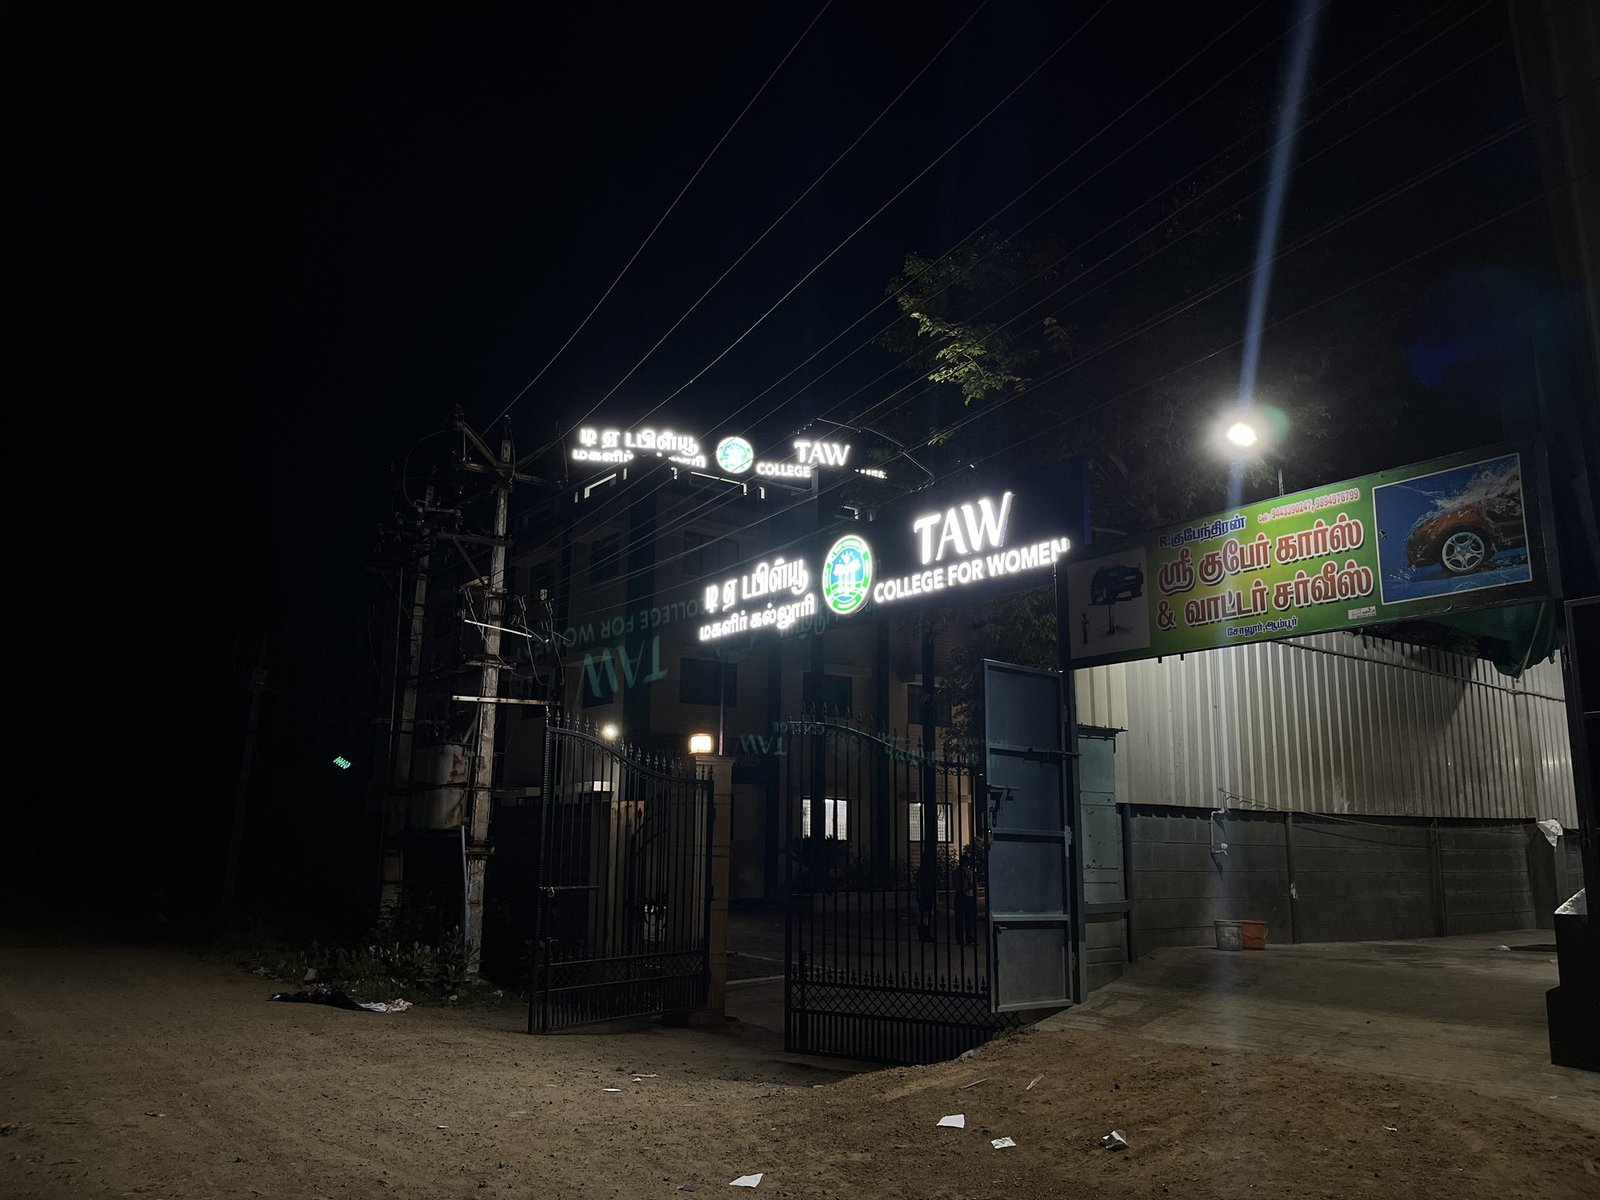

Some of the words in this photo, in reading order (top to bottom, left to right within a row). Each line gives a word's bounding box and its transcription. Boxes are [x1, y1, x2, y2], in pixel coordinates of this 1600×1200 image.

[793, 440, 850, 466] TAW
[756, 462, 812, 478] COLLEGE
[914, 491, 1013, 565] TAW
[873, 567, 943, 604] COLLEGE
[947, 558, 984, 586] FOR
[986, 537, 1071, 577] WOMEN
[705, 585, 719, 614] டி
[722, 578, 738, 612] ஏ
[699, 609, 749, 641] மகளிர்
[1157, 600, 1176, 630] &
